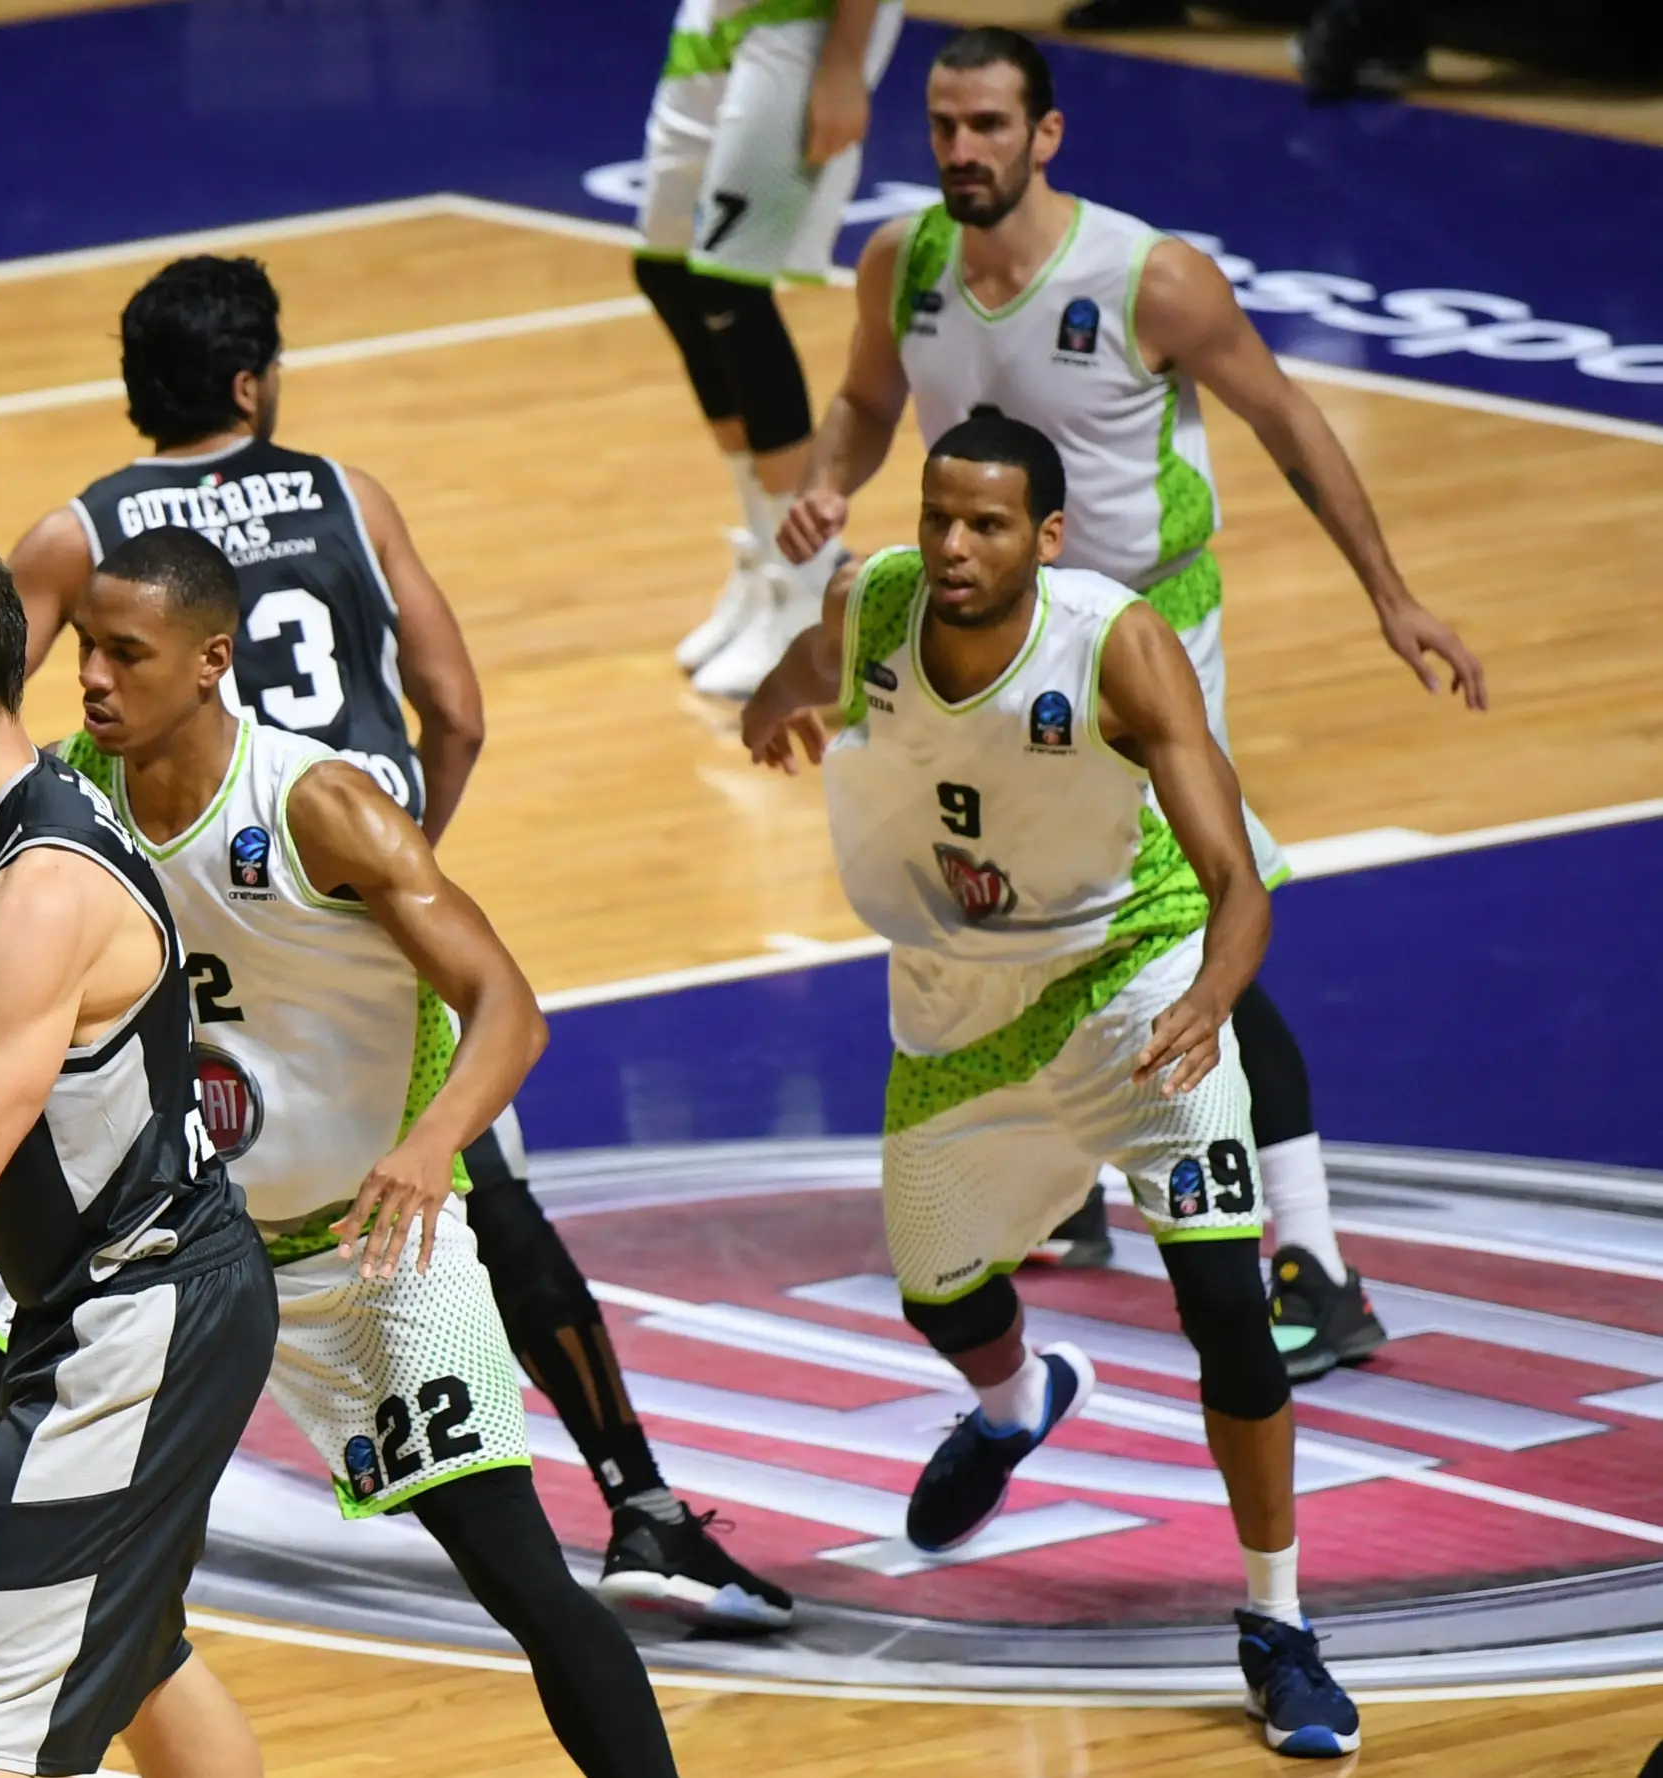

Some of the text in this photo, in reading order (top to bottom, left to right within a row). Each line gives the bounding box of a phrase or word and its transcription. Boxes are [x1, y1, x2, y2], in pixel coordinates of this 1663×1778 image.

[936, 780, 982, 839] 9
[1207, 1138, 1255, 1214] 9
[375, 1375, 484, 1485] 22
